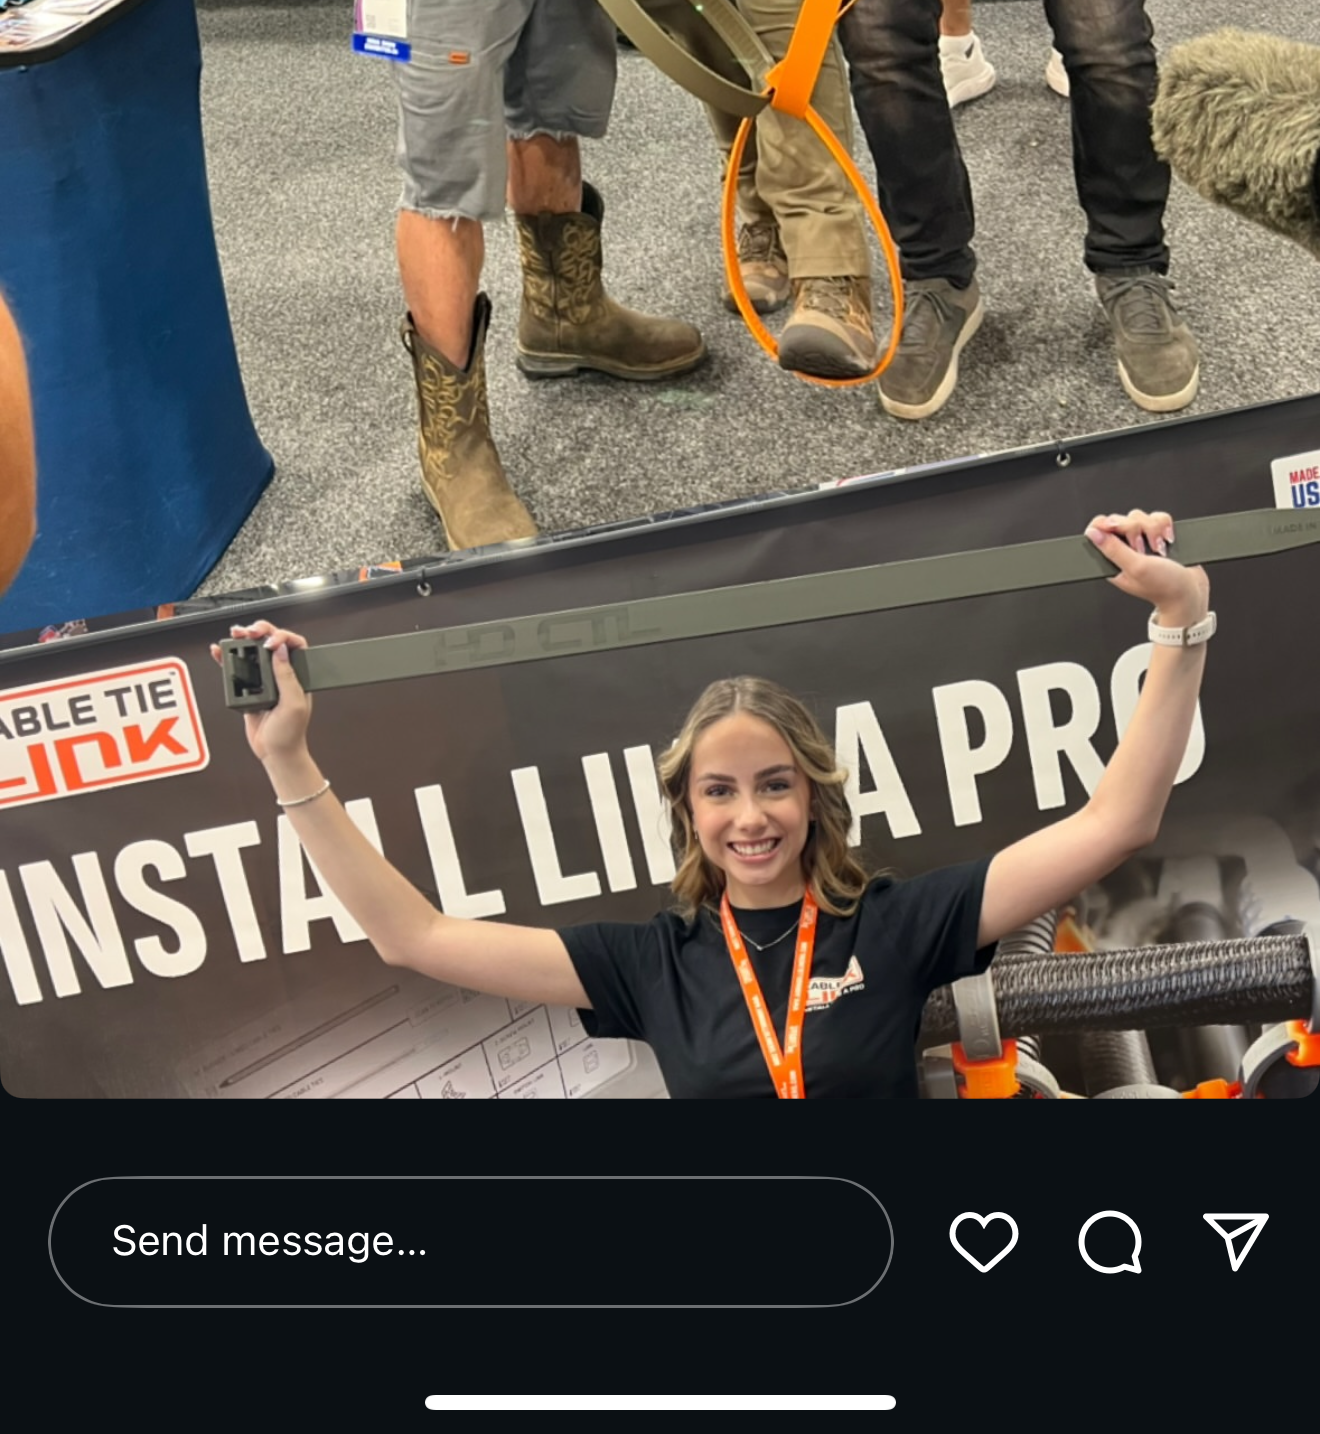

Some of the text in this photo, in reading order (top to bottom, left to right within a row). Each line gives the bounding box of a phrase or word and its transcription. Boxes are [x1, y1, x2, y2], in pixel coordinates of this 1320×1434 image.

[1289, 465, 1320, 484] MADE
[103, 678, 178, 718] TIE
[0, 784, 506, 1005] INSTAL
[510, 738, 680, 906] LI
[835, 700, 923, 848] A
